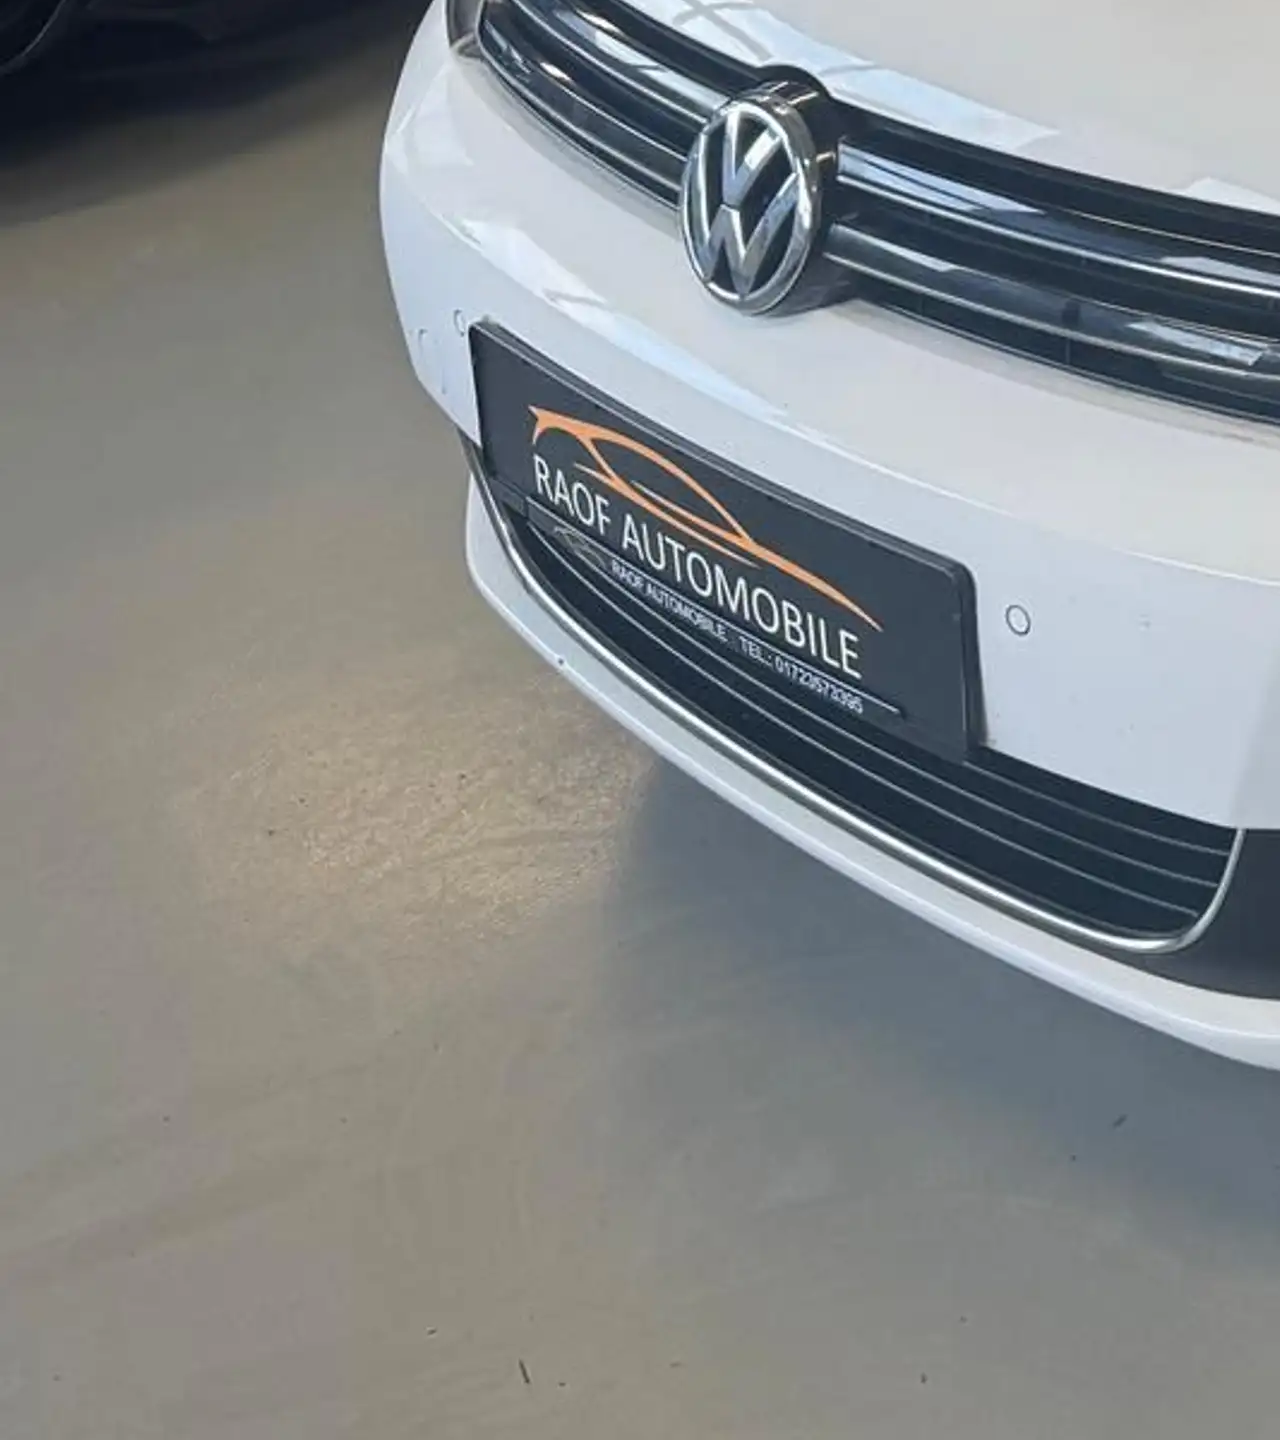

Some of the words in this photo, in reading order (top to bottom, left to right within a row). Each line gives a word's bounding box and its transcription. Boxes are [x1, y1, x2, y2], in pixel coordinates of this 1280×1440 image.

[533, 453, 612, 536] RAOF
[622, 513, 863, 680] AUTOMOBILE
[611, 558, 645, 590] RAOF
[645, 583, 728, 643] AUTOMOBILE
